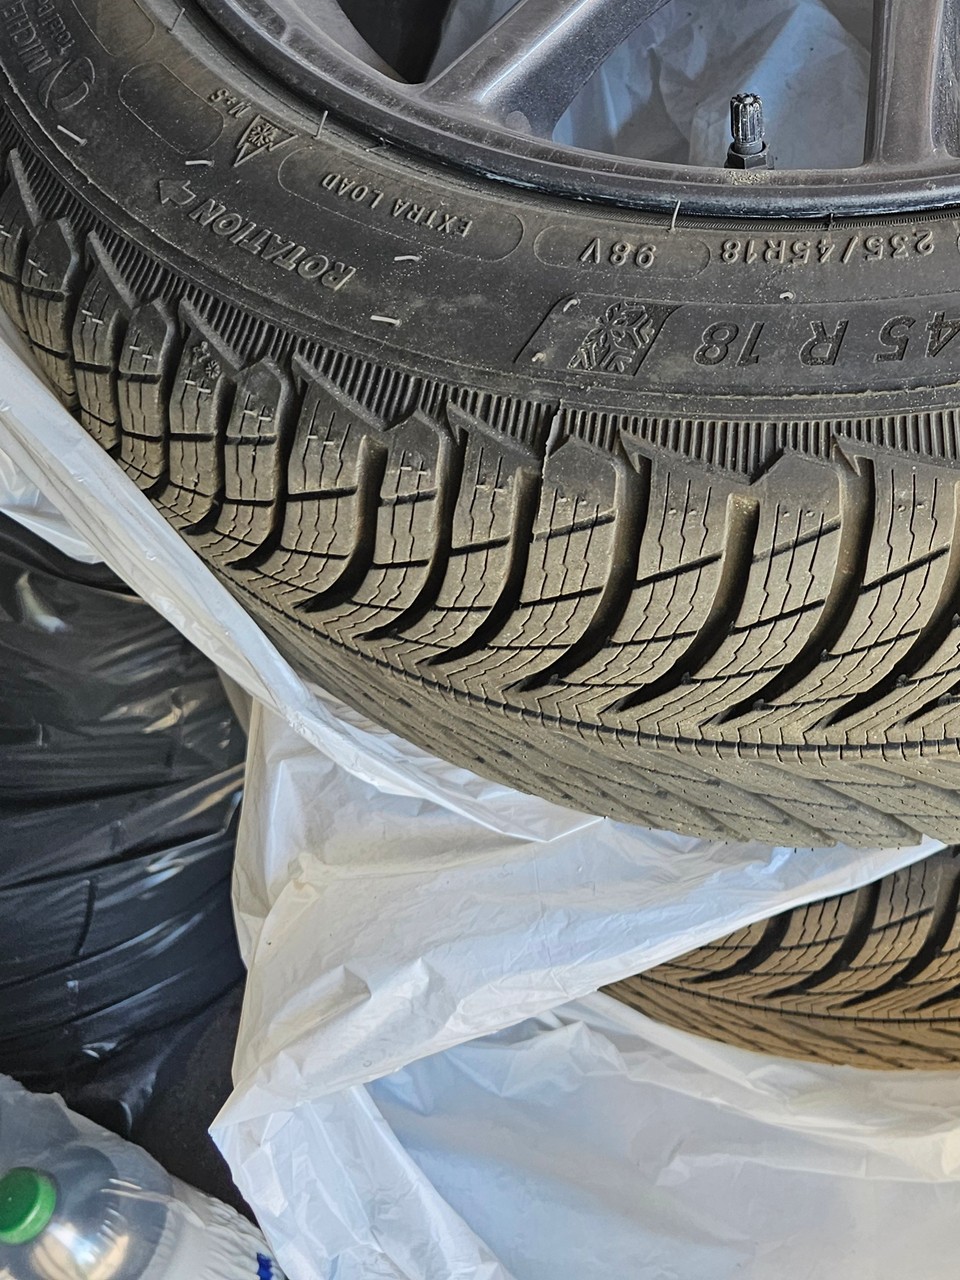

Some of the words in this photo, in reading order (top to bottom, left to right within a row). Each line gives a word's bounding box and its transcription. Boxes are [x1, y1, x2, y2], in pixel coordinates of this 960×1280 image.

[42, 13, 76, 56] Total
[208, 88, 252, 119] M+S
[320, 173, 385, 209] LOAD
[391, 198, 473, 238] EXTRA
[188, 197, 357, 291] ROTATION
[721, 229, 936, 265] 235/45R18
[694, 320, 766, 367] 18
[799, 320, 850, 366] R
